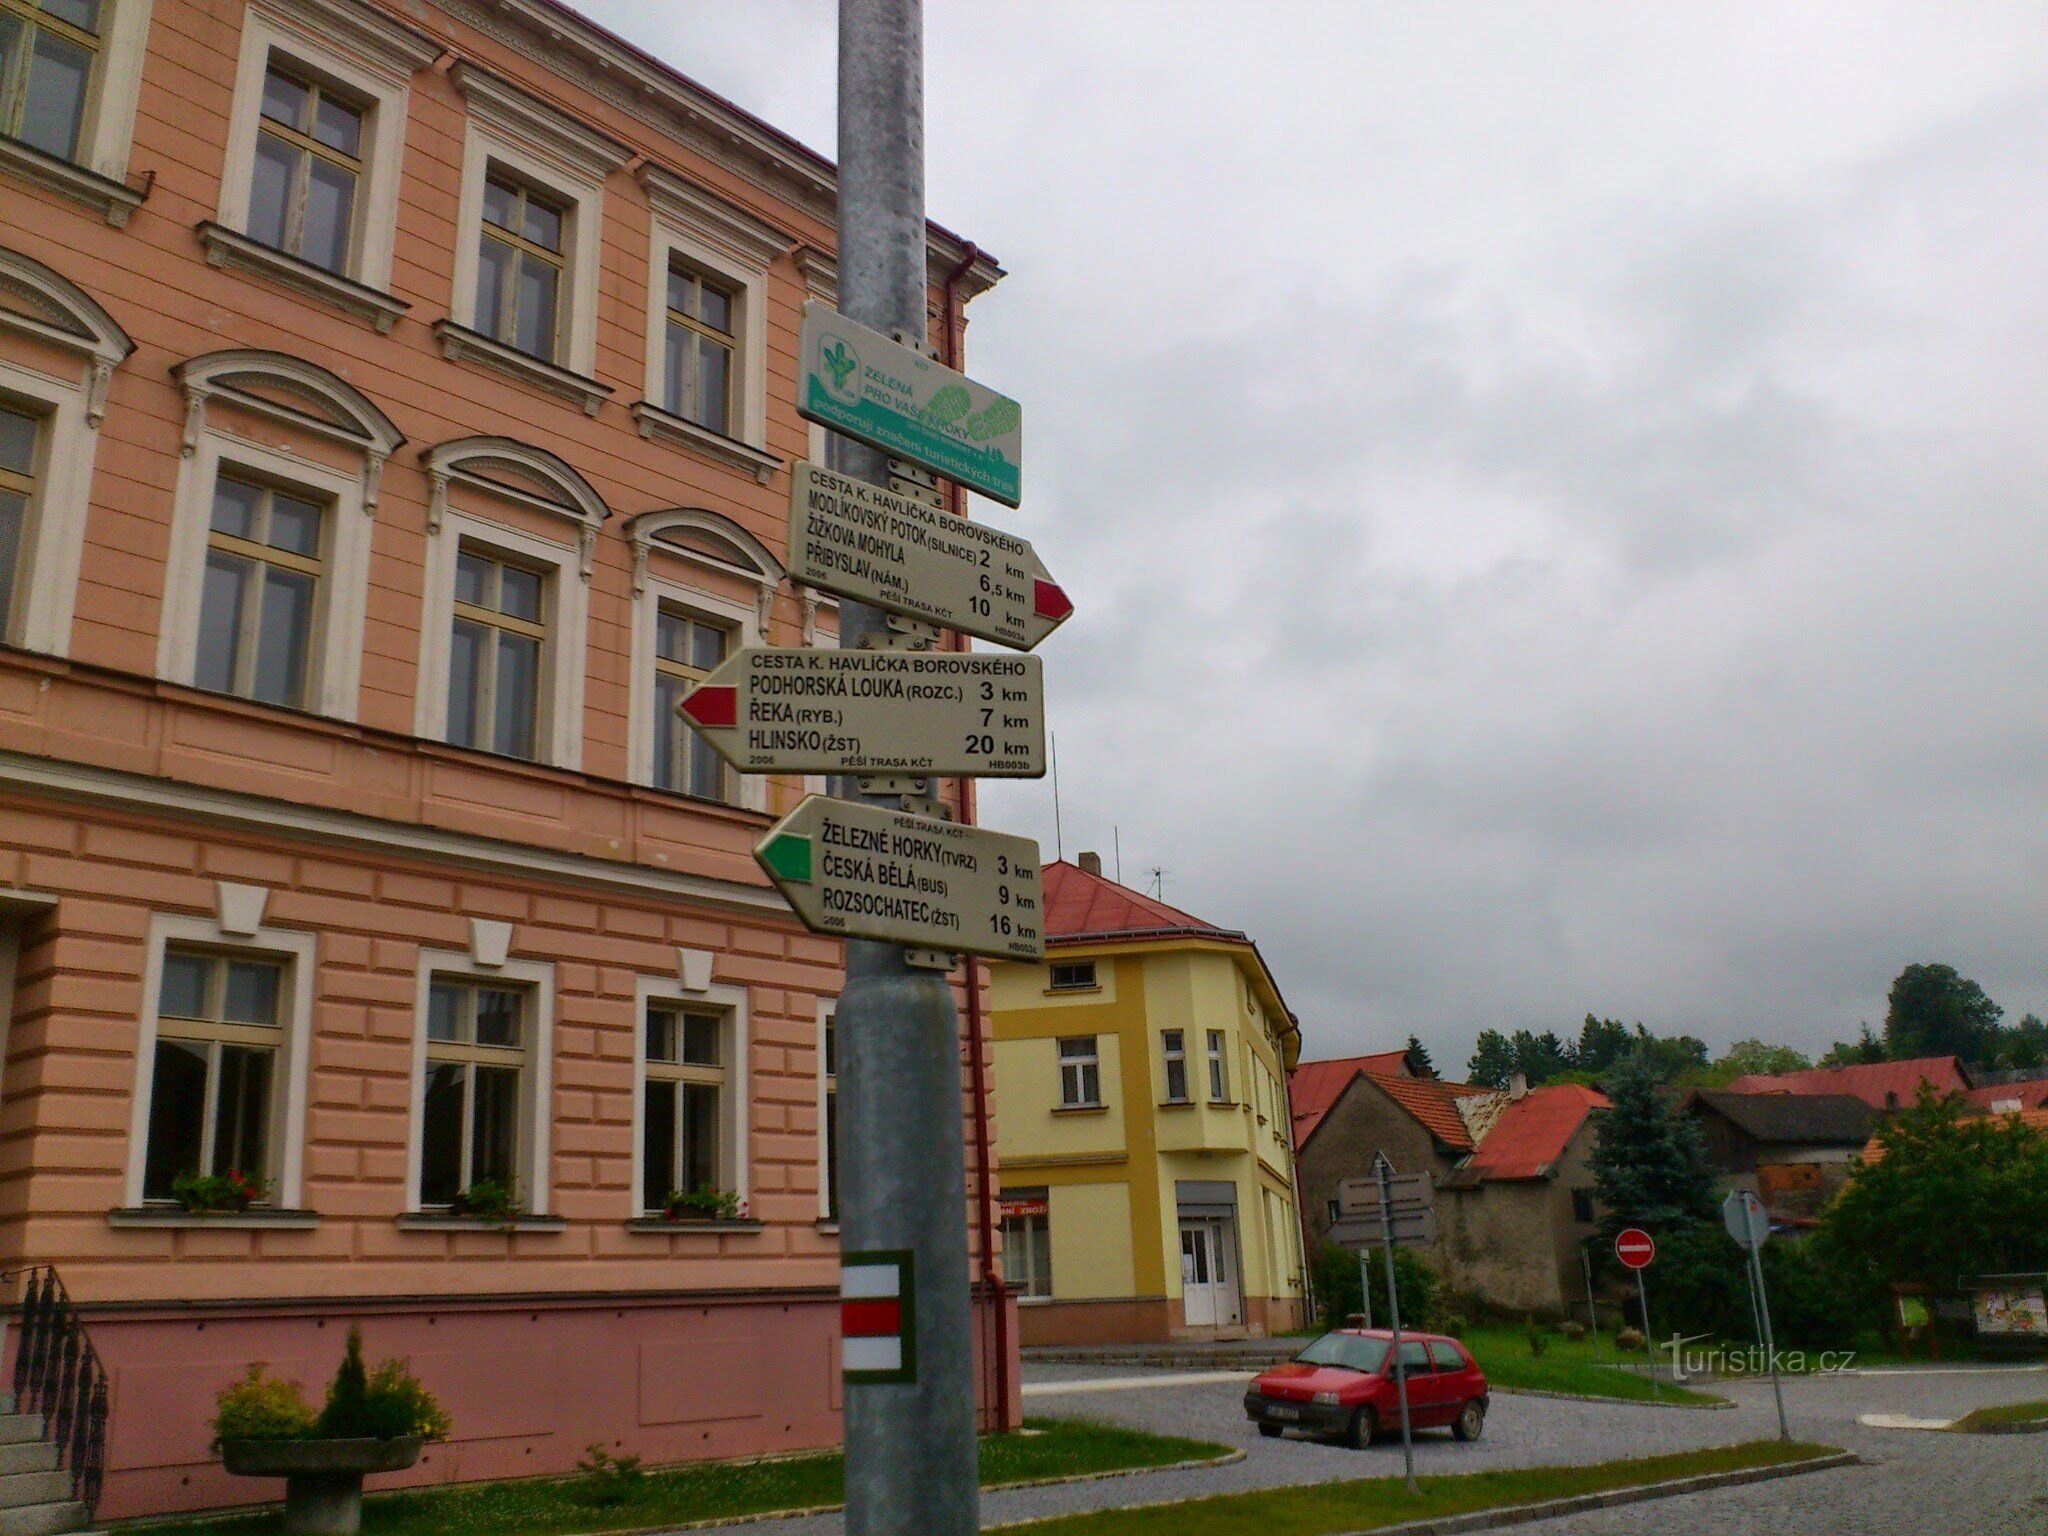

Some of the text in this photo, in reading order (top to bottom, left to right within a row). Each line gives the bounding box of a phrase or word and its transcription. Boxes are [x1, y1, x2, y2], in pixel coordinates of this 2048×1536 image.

[865, 366, 913, 397] ZELENÁ
[865, 385, 891, 405] PRO
[810, 471, 1024, 556] CESTA K. HAVLÍČKA BOROVSKÉHO
[808, 489, 889, 533] MODLÍKOVSKÝ
[980, 549, 991, 569] 2
[1006, 563, 1025, 580] km
[807, 512, 855, 548] ŽIŽKOVA
[857, 532, 905, 565] MOHYLA
[1006, 588, 1025, 604] km
[903, 596, 932, 615] TRASA
[969, 596, 990, 616] 10
[1006, 612, 1025, 628] km
[752, 655, 1026, 676] CESTA K. HAVLÍČKA BOROVSKÉHO
[750, 672, 848, 697] PODHORSKÁ
[980, 681, 994, 700] 3
[1002, 688, 1028, 702] km
[980, 708, 994, 727] 7
[1003, 714, 1029, 728] km
[965, 735, 995, 755] 20
[1004, 741, 1029, 756] km
[749, 755, 775, 765] 2006
[870, 757, 908, 768] TRASA
[911, 757, 933, 768] KČT
[989, 760, 1030, 770] HB003b
[916, 821, 944, 834] TRASA
[822, 816, 889, 854] ŽELEZNÉ
[998, 855, 1008, 875] 3
[1014, 864, 1033, 880] km
[823, 849, 874, 884] ČESKÁ
[998, 885, 1010, 905] 9
[1016, 893, 1035, 909] km
[990, 913, 1011, 935] 16
[1017, 924, 1036, 939] km
